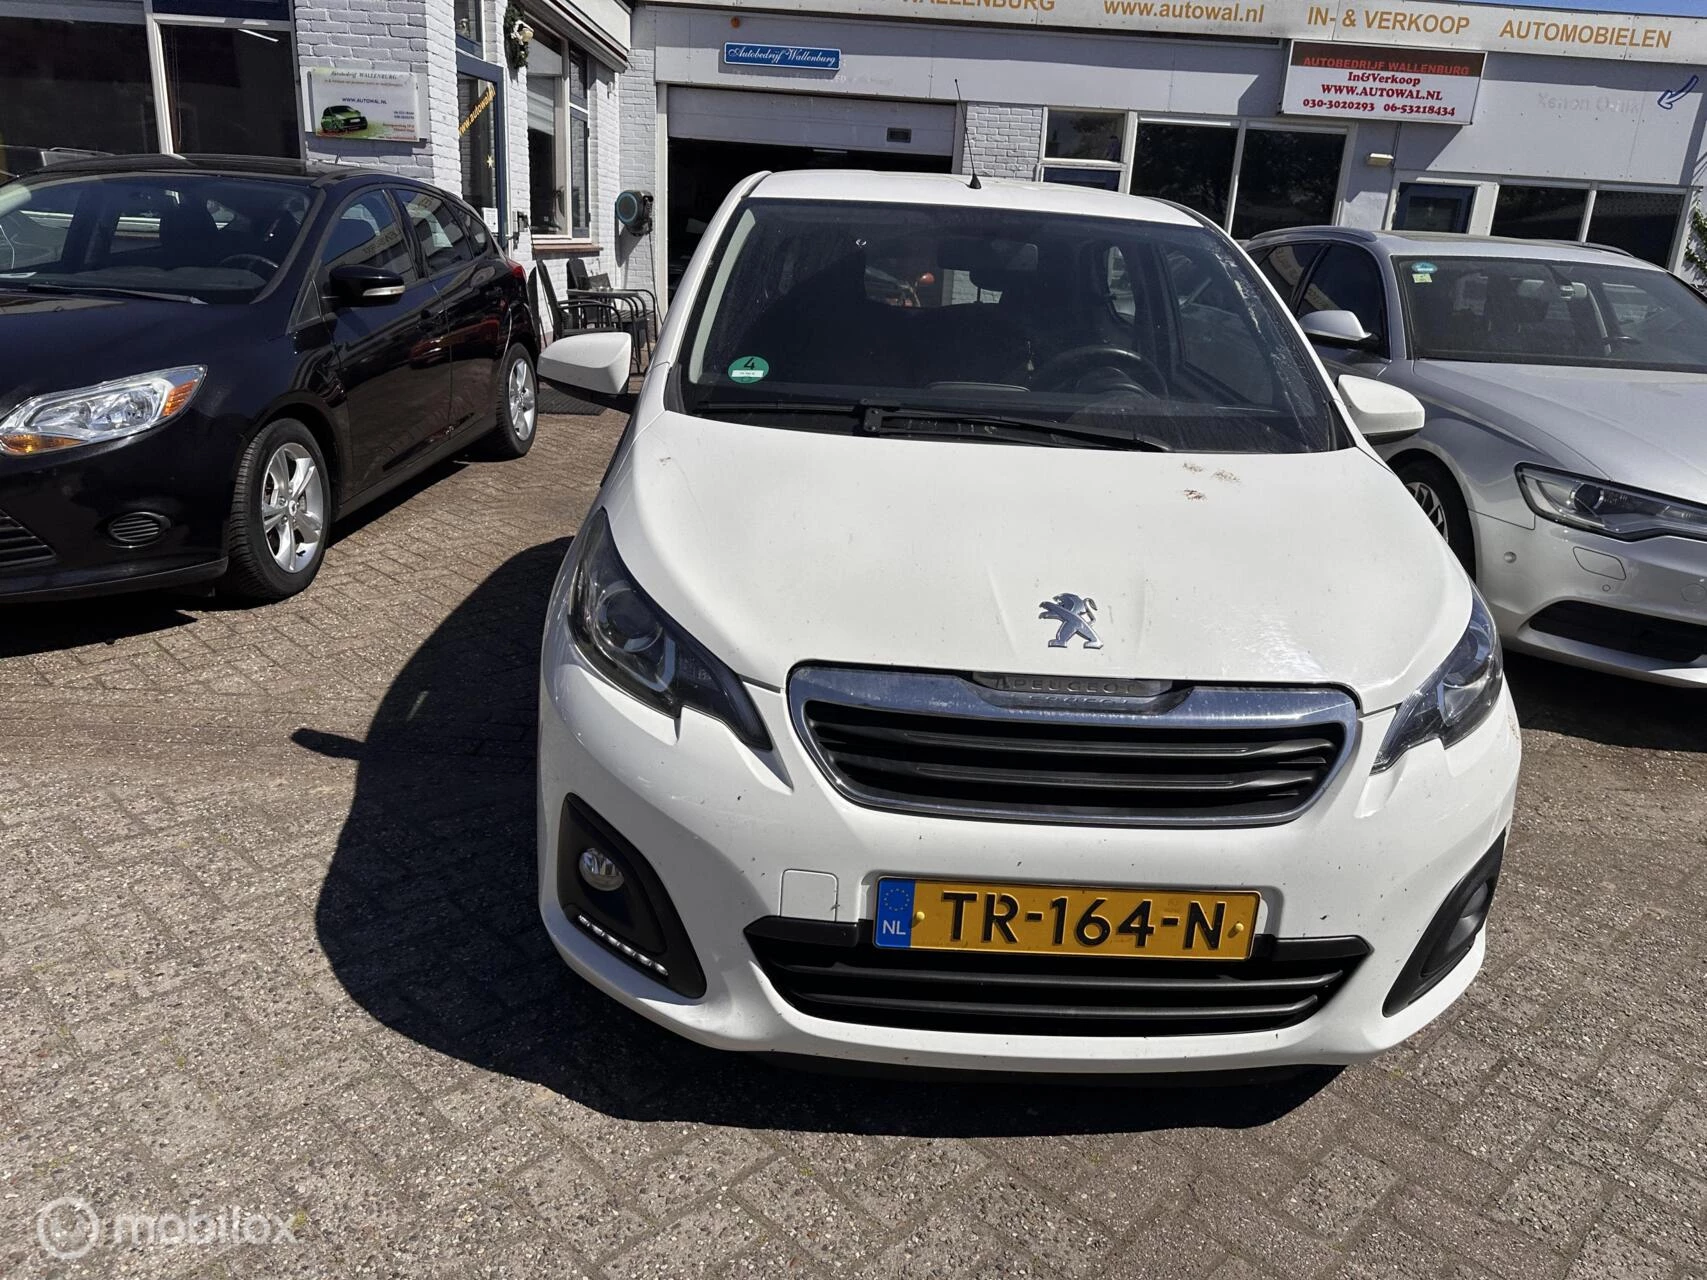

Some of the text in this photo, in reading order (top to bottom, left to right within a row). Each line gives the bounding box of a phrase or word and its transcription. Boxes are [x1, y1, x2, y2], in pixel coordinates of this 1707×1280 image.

[1103, 0, 1265, 23] www.autowal.nl
[1307, 7, 1337, 26] IN-
[1342, 9, 1357, 27] &
[1363, 10, 1470, 35] VERKOOP
[1500, 19, 1672, 49] AUTOMOBIELEN
[728, 46, 837, 67] Autobedrijf Wallenburg
[1303, 57, 1470, 76] AUTOBEDRIJF WALLENBURG
[1347, 71, 1421, 87] In&Verkoop
[1321, 84, 1443, 101] WWW.AUTOWAL.NL
[1302, 98, 1456, 117] 030-3020293 06-53218434
[743, 357, 755, 370] 4
[881, 919, 907, 936] NL
[942, 890, 1227, 950] TR-164-N
